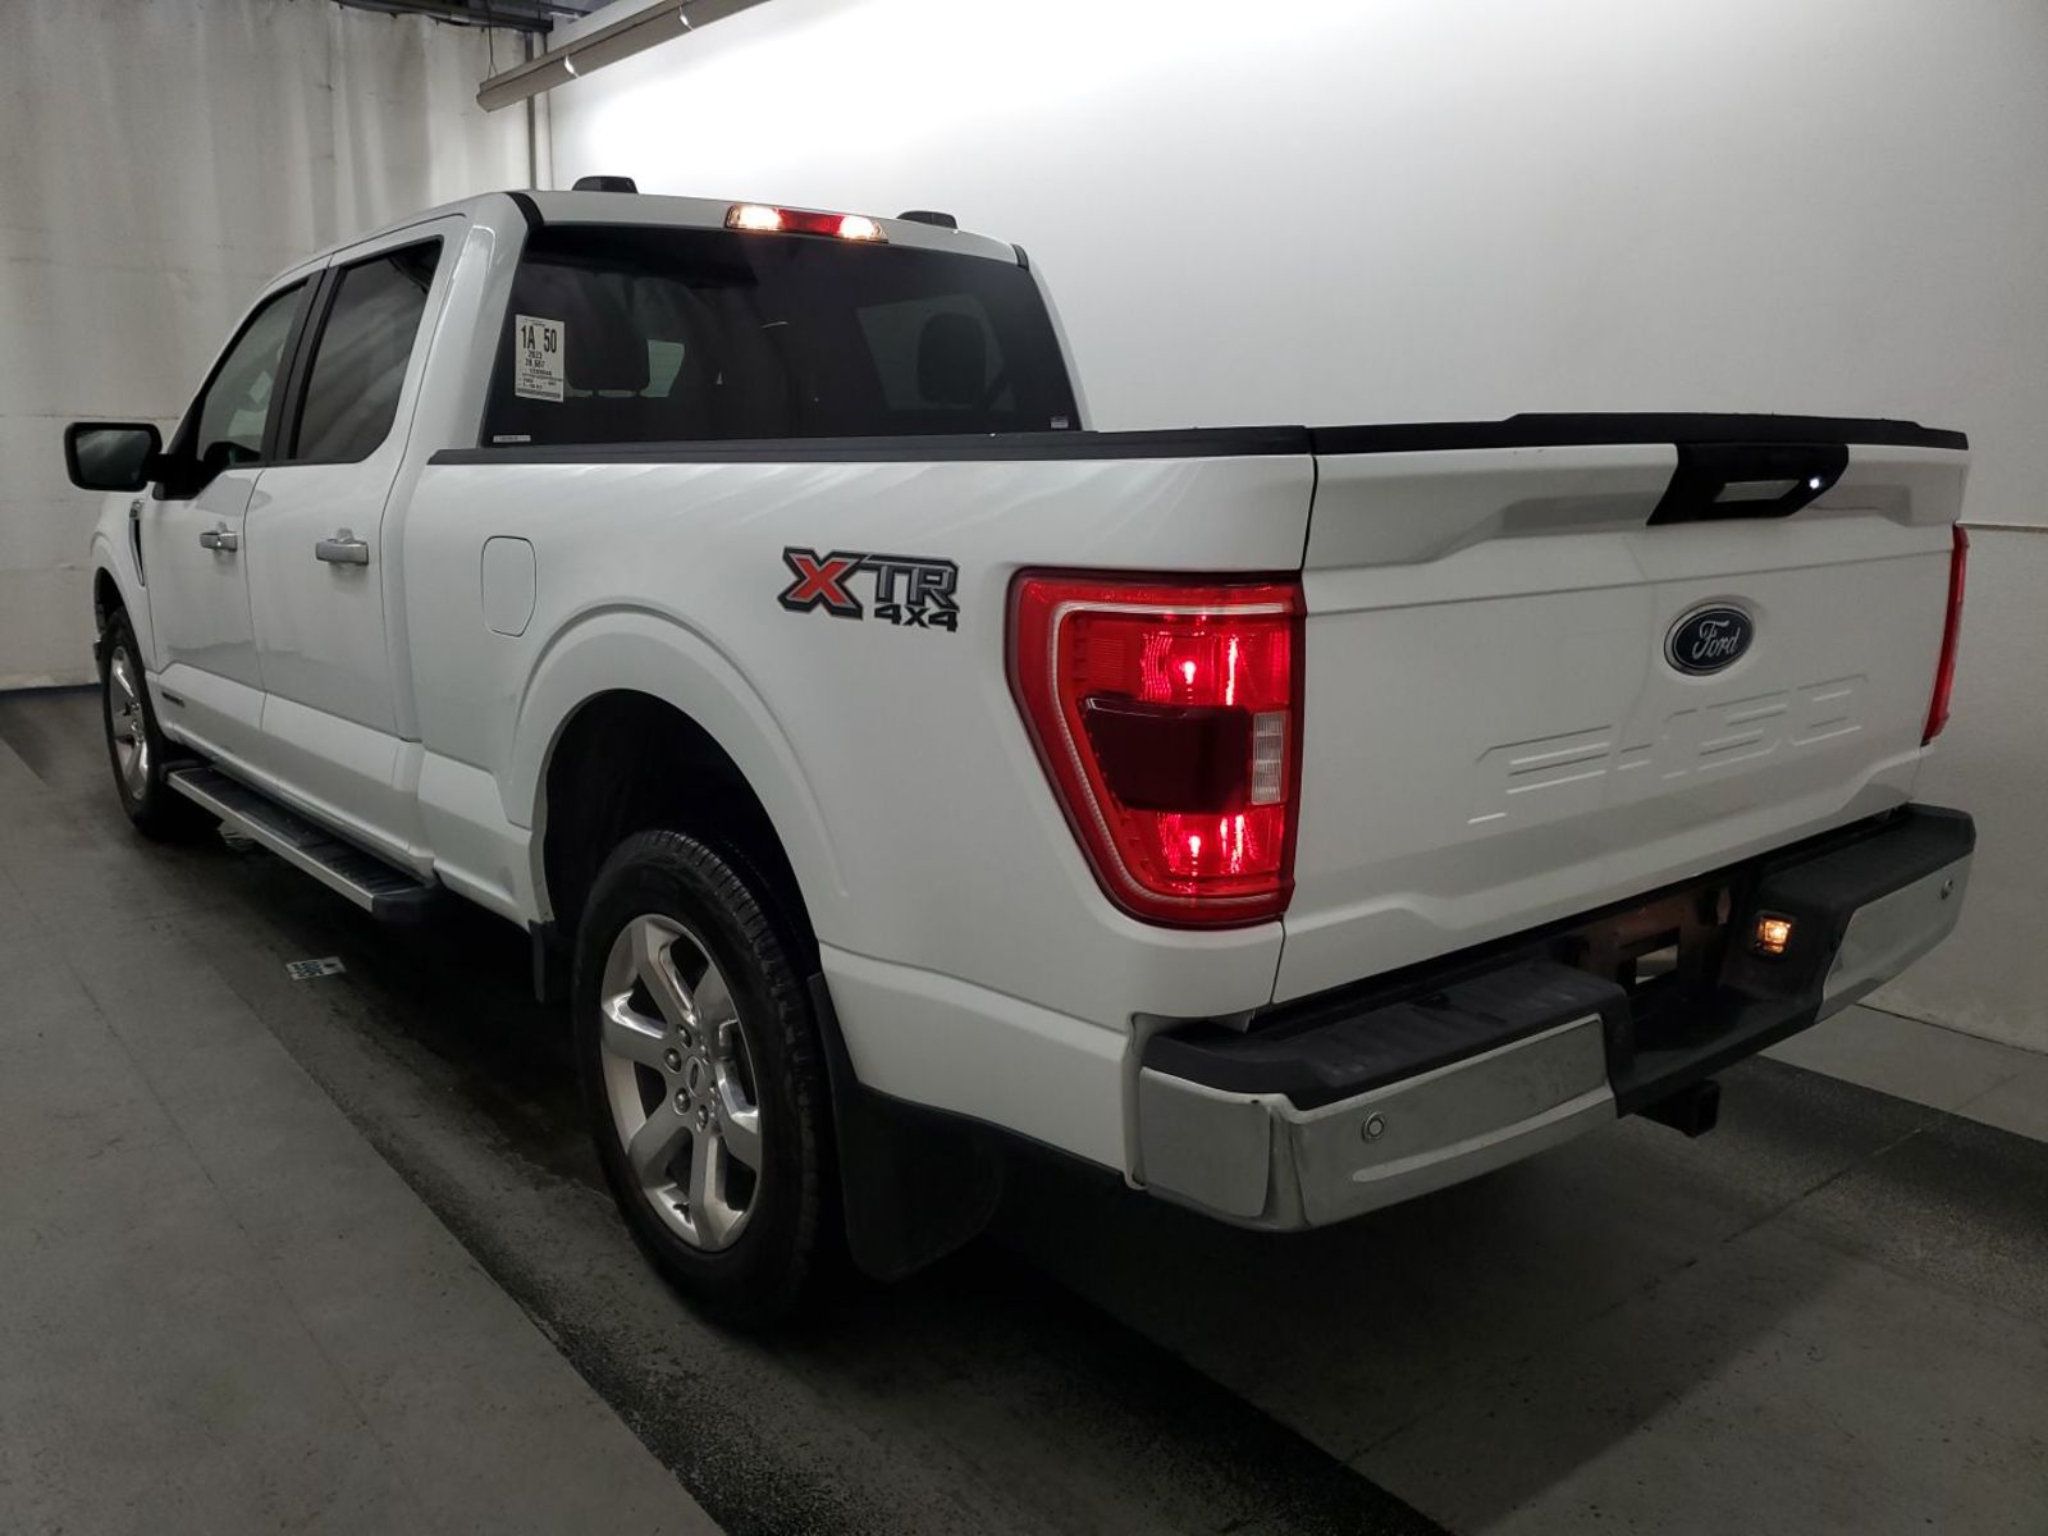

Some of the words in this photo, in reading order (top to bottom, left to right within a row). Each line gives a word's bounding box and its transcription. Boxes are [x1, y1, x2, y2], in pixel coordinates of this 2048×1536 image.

[521, 325, 536, 349] 1A
[544, 328, 557, 353] 50
[777, 546, 960, 621] XTR
[1692, 619, 1741, 660] Ford
